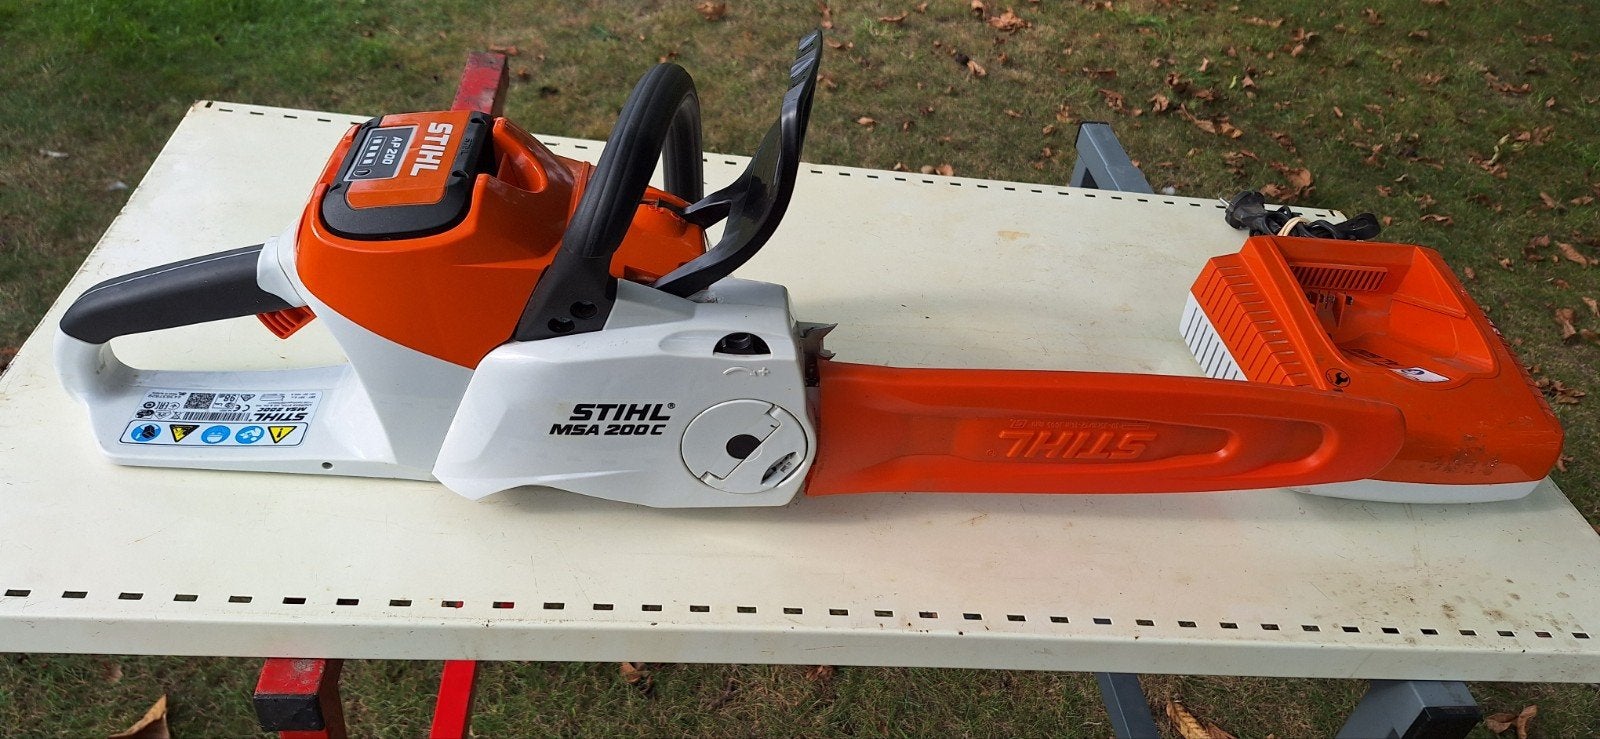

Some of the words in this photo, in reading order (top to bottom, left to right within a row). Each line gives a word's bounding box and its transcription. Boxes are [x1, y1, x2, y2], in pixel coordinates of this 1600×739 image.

[392, 137, 403, 148] AP
[410, 122, 453, 176] STIHL
[382, 148, 398, 165] 200
[253, 412, 308, 422] STIHL
[549, 423, 600, 436] MSA
[998, 431, 1158, 459] STIHL
